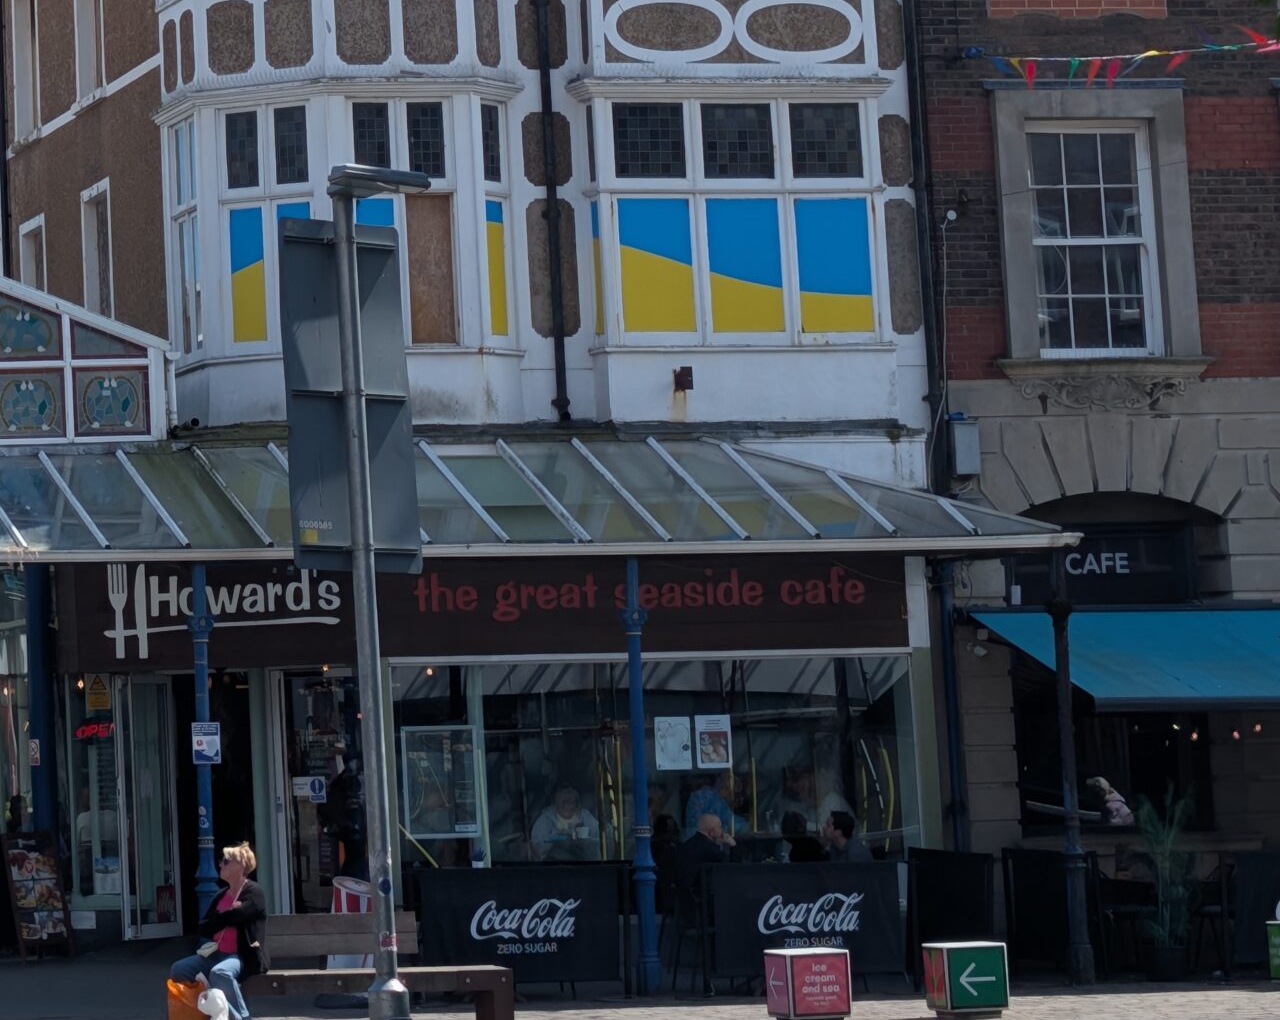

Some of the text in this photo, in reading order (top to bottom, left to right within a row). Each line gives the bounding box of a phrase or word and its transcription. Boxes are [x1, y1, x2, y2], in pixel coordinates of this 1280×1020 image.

[1065, 552, 1130, 575] CAFE
[413, 573, 479, 612] the
[492, 575, 598, 622] great
[780, 565, 866, 606] cafe
[470, 898, 582, 940] Coca-Cola
[758, 892, 864, 935] Coca-Cola
[497, 942, 558, 954] ZERO SUGAR
[784, 936, 844, 948] ZERO SUGAR
[805, 974, 836, 983] cream
[802, 984, 820, 993] and
